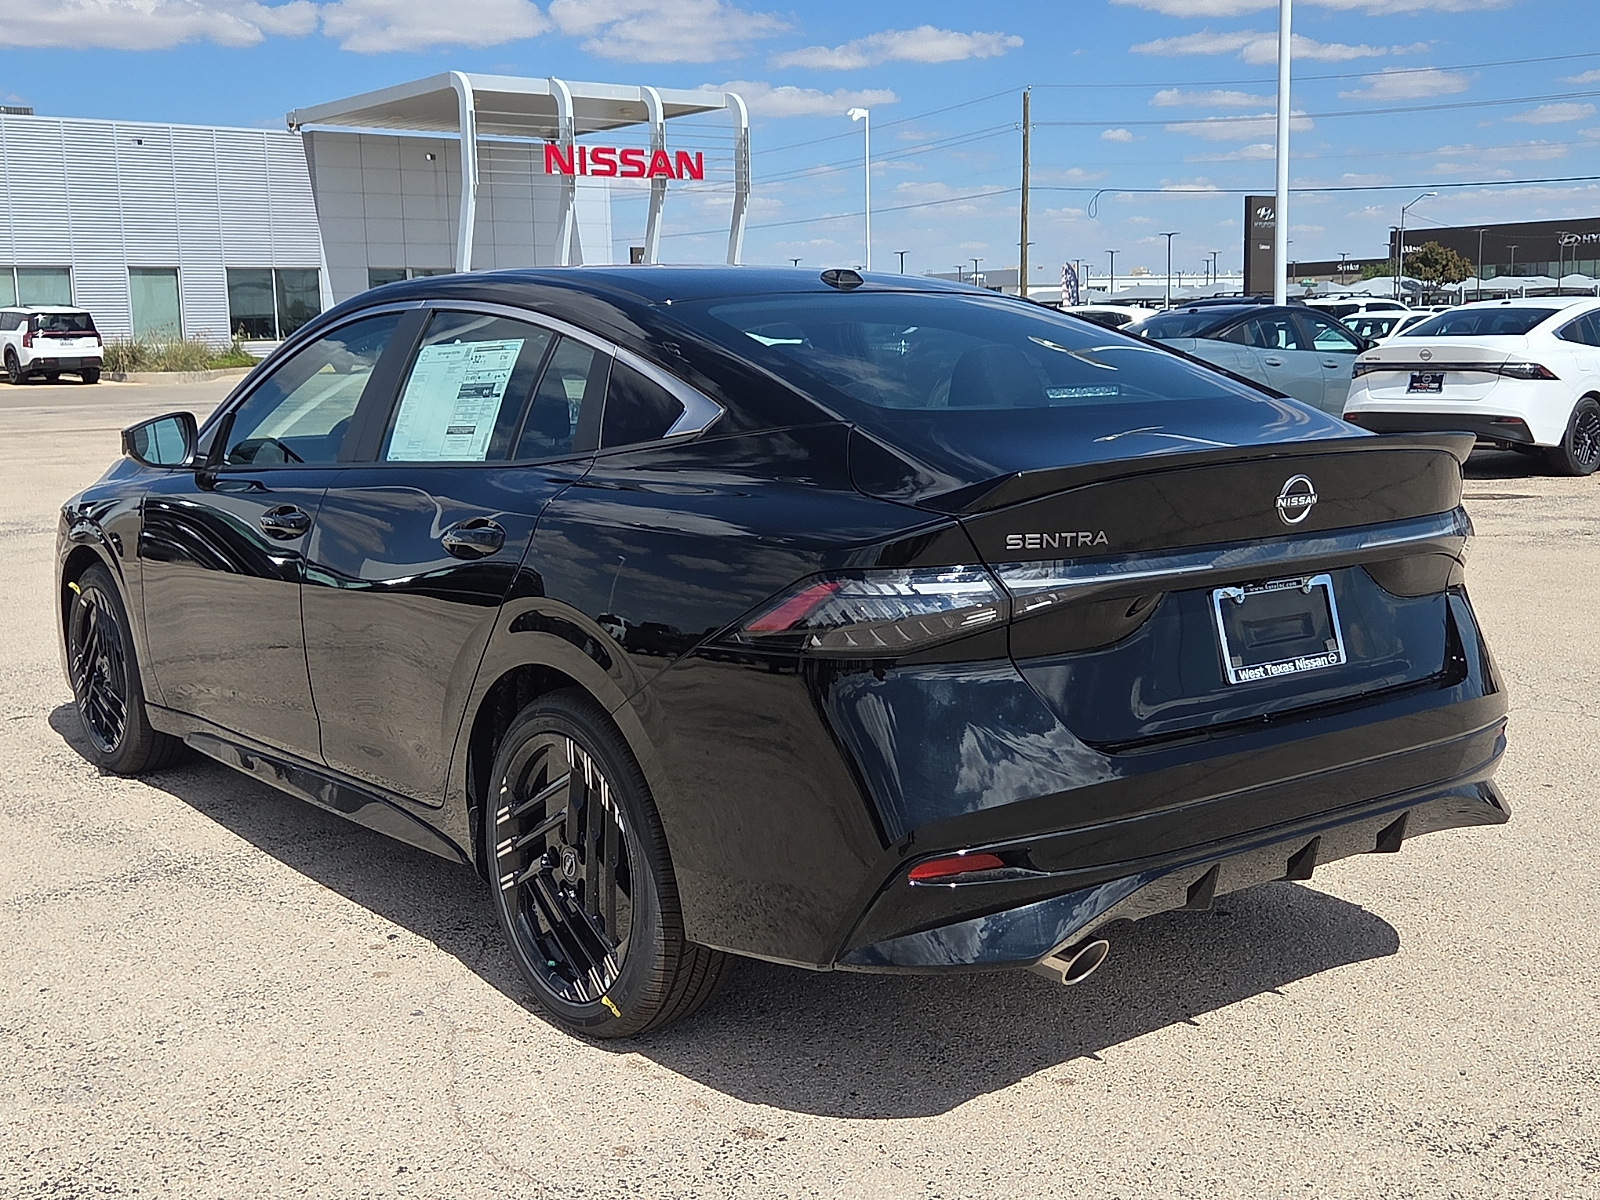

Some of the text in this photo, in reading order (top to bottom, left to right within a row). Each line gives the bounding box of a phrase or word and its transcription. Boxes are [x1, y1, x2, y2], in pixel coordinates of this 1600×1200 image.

[543, 143, 704, 180] NISSAN
[1582, 233, 1600, 244] HY
[1277, 493, 1318, 508] NISSAN
[1005, 530, 1109, 550] SENTRA
[1238, 656, 1328, 680] West Texas Nissan
